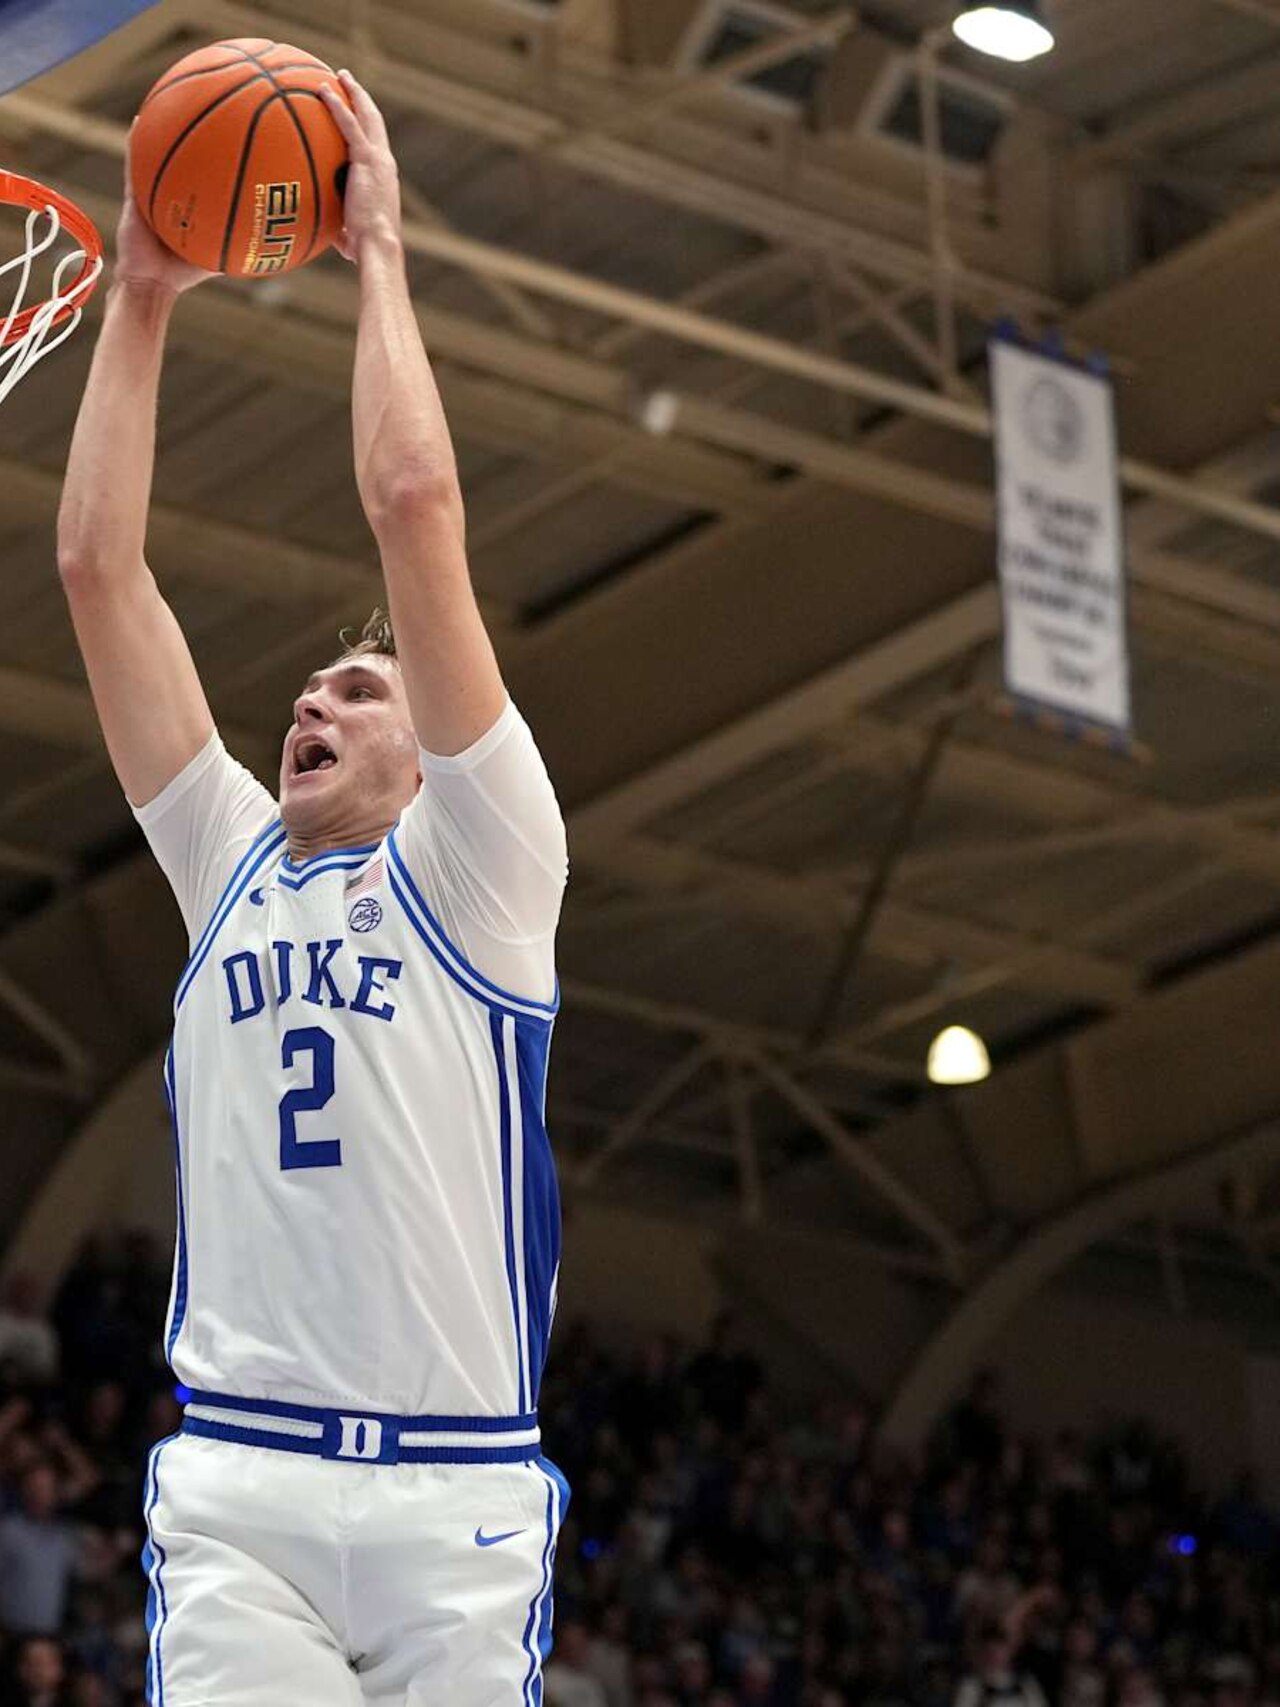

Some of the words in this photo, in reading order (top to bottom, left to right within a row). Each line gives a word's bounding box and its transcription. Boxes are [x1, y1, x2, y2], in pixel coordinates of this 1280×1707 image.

[254, 181, 301, 273] ELITE
[354, 905, 379, 920] ACC
[278, 1026, 343, 1172] 2
[336, 1416, 383, 1460] D
